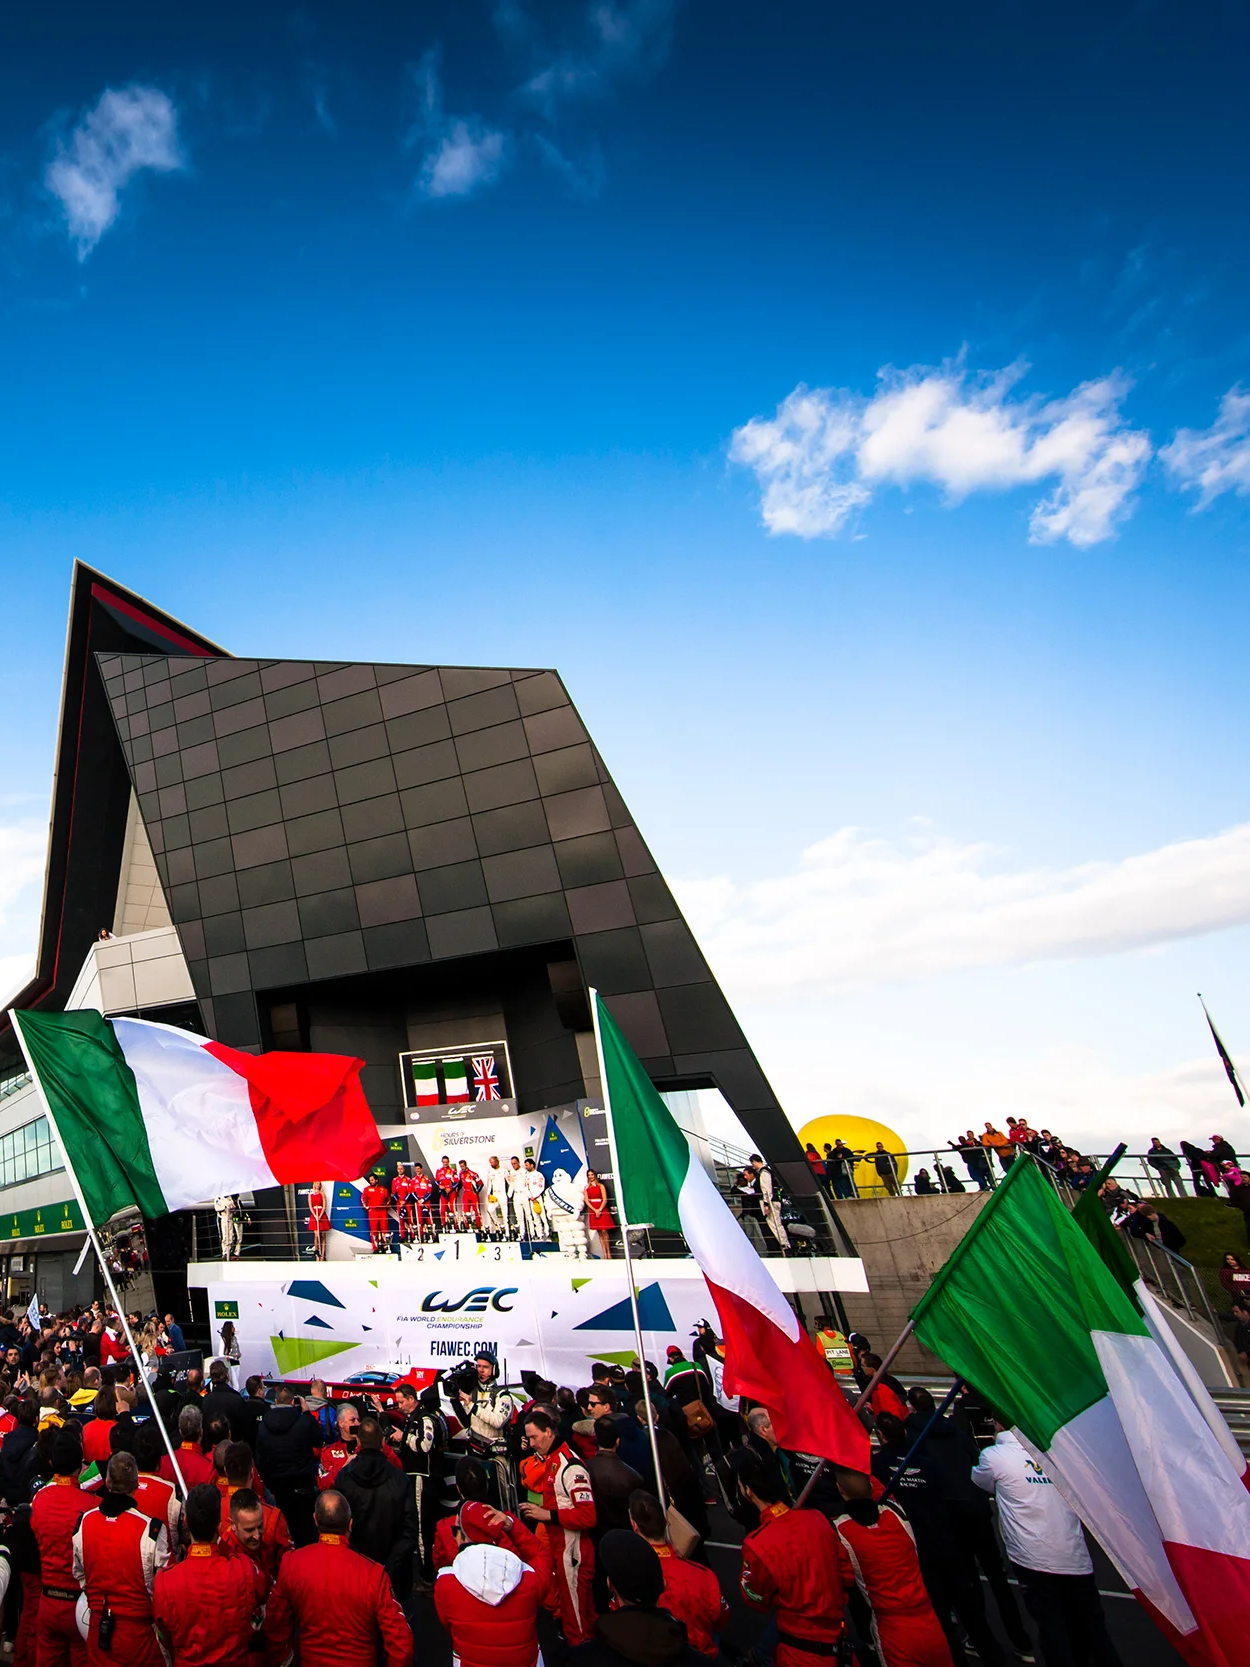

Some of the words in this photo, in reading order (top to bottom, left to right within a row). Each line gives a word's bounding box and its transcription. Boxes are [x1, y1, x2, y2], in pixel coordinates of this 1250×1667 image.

[448, 1104, 477, 1115] WEC
[443, 1134, 496, 1146] SILVERSTONE
[417, 1247, 425, 1261] 2
[454, 1239, 460, 1260] 1
[494, 1246, 501, 1260] 3
[420, 1286, 519, 1313] WEC
[430, 1340, 498, 1357] FIAWEC.COM
